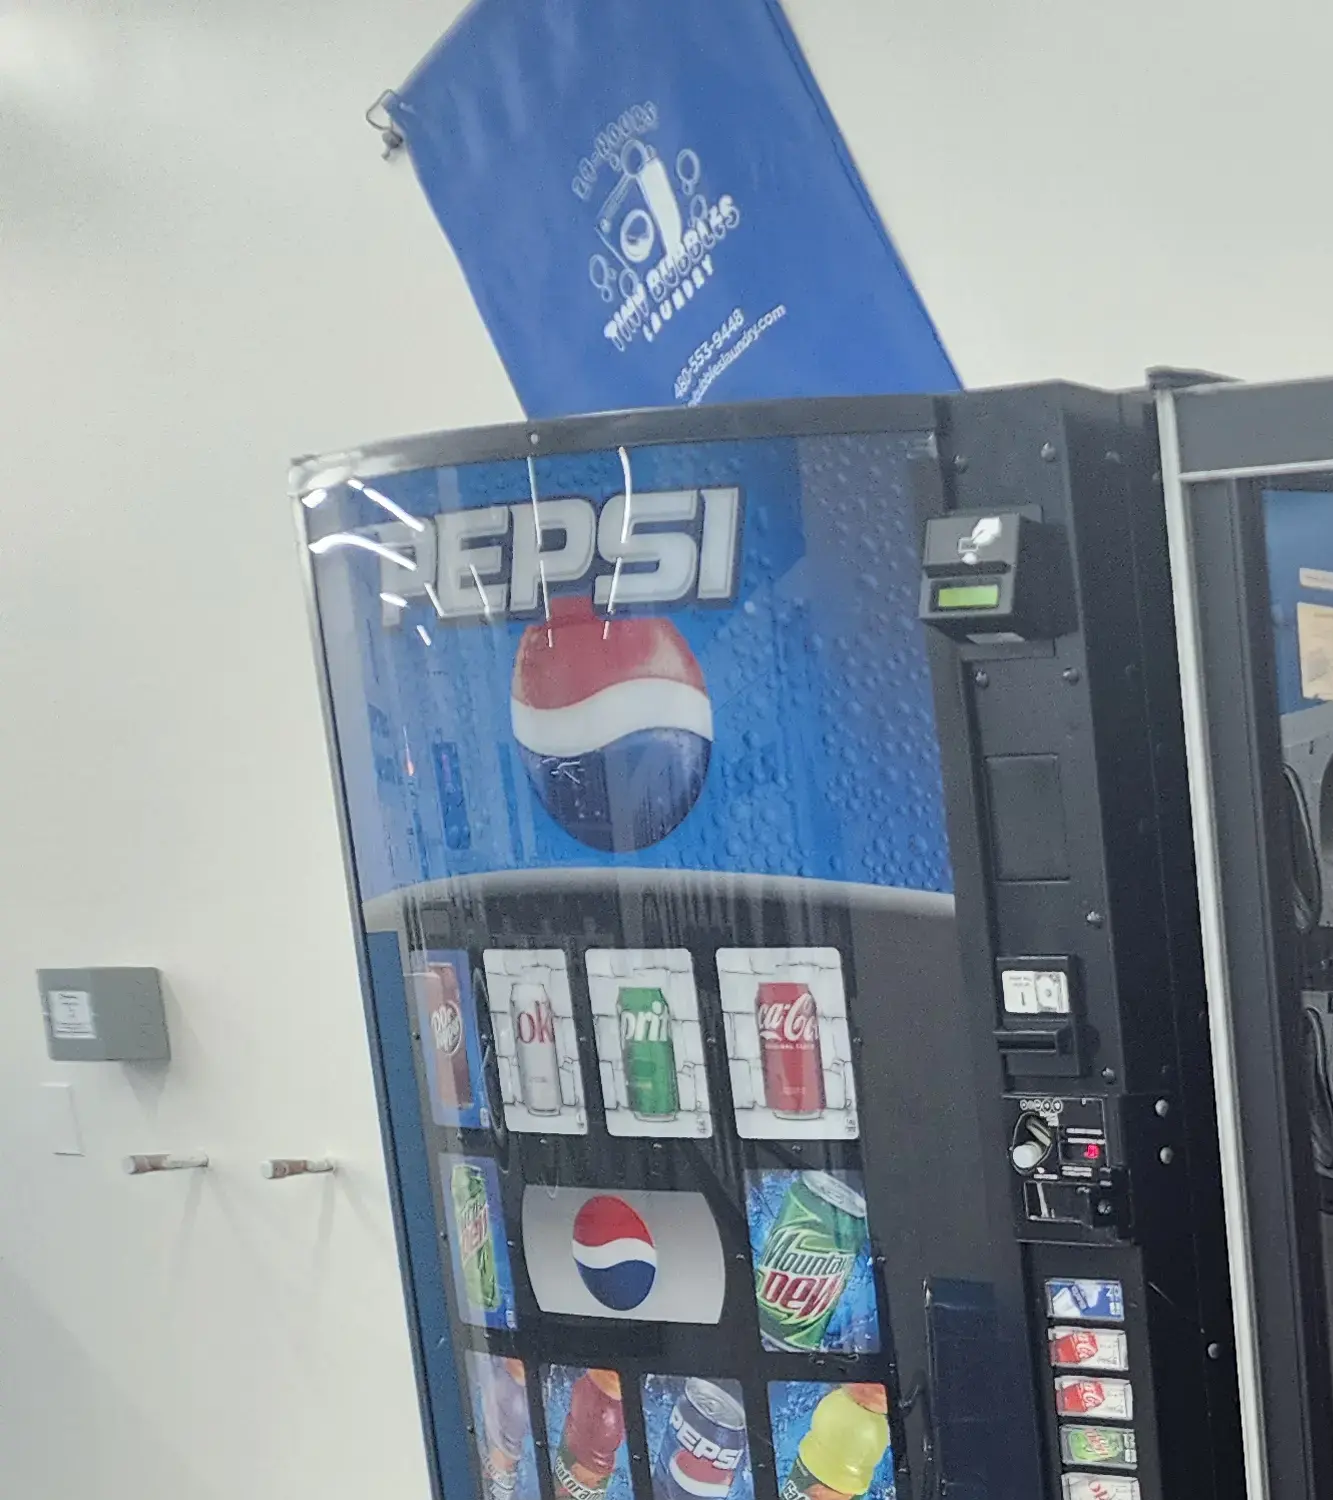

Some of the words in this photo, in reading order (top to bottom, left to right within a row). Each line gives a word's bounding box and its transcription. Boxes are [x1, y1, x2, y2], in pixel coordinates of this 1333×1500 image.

[603, 282, 650, 352] TINY
[646, 194, 740, 302] BUBBLES
[643, 254, 714, 342] LAUNDRY
[674, 308, 745, 399] 480-553-9448
[364, 486, 742, 624] PEPSI
